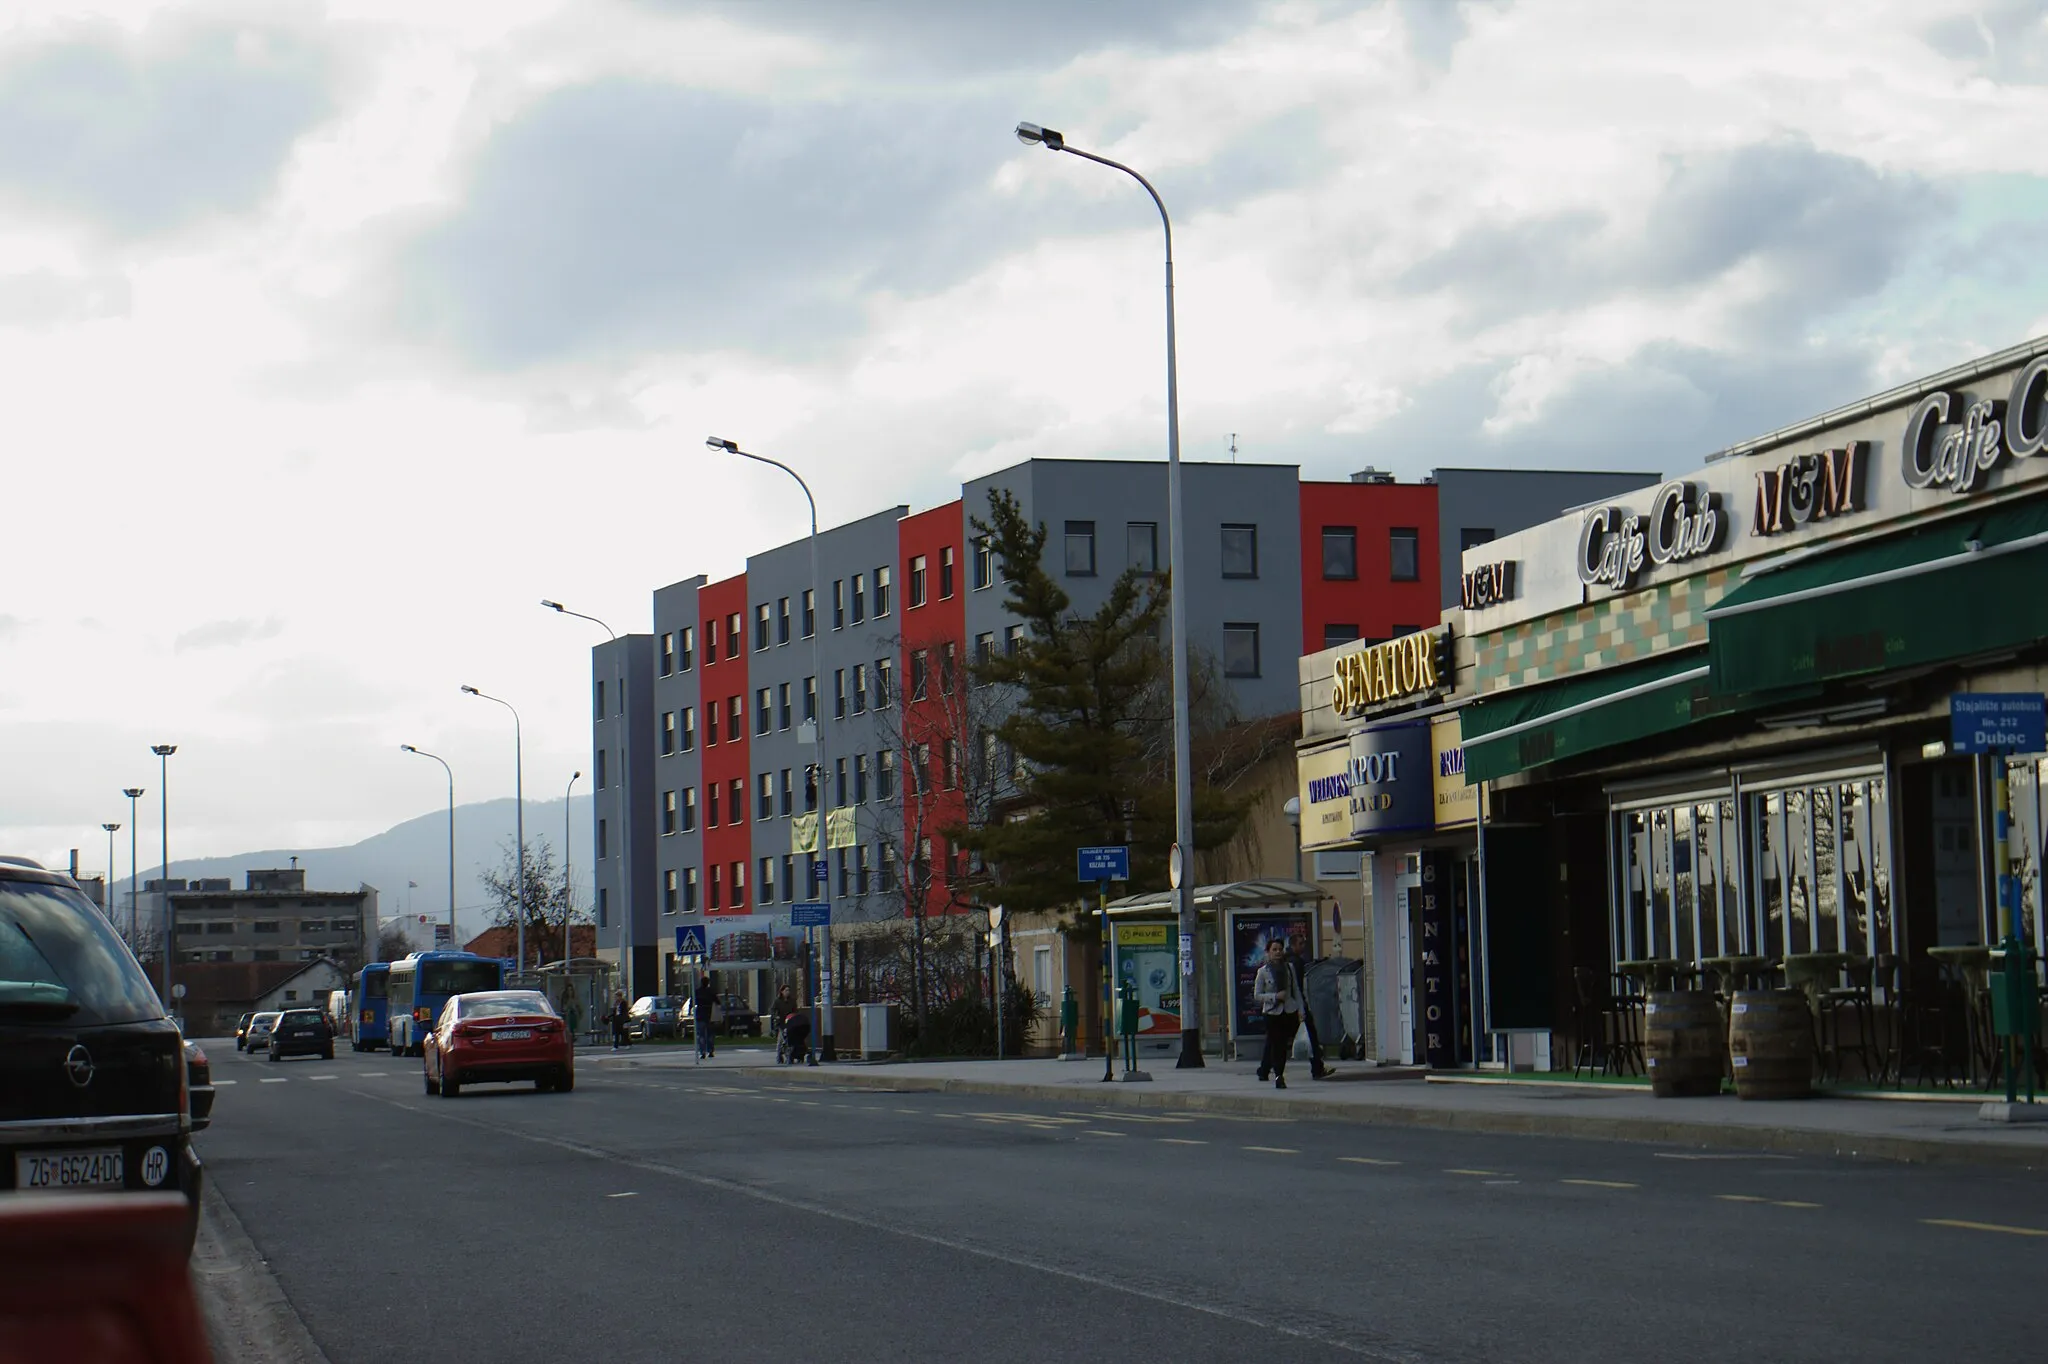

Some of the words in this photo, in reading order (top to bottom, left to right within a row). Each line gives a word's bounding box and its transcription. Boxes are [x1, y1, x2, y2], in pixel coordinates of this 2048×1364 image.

[1901, 391, 2001, 493] Caffe
[1750, 441, 1861, 537] M&M
[1577, 506, 1646, 590] Caffe
[1649, 480, 1719, 565] Club
[1460, 560, 1510, 610] M&M
[1332, 632, 1436, 715] SENATOR
[1347, 751, 1401, 787] KPOT
[1975, 731, 2026, 744] Dubec
[1422, 864, 1444, 1049] SENATOR
[29, 1158, 50, 1186] ZG
[146, 1151, 164, 1180] HR
